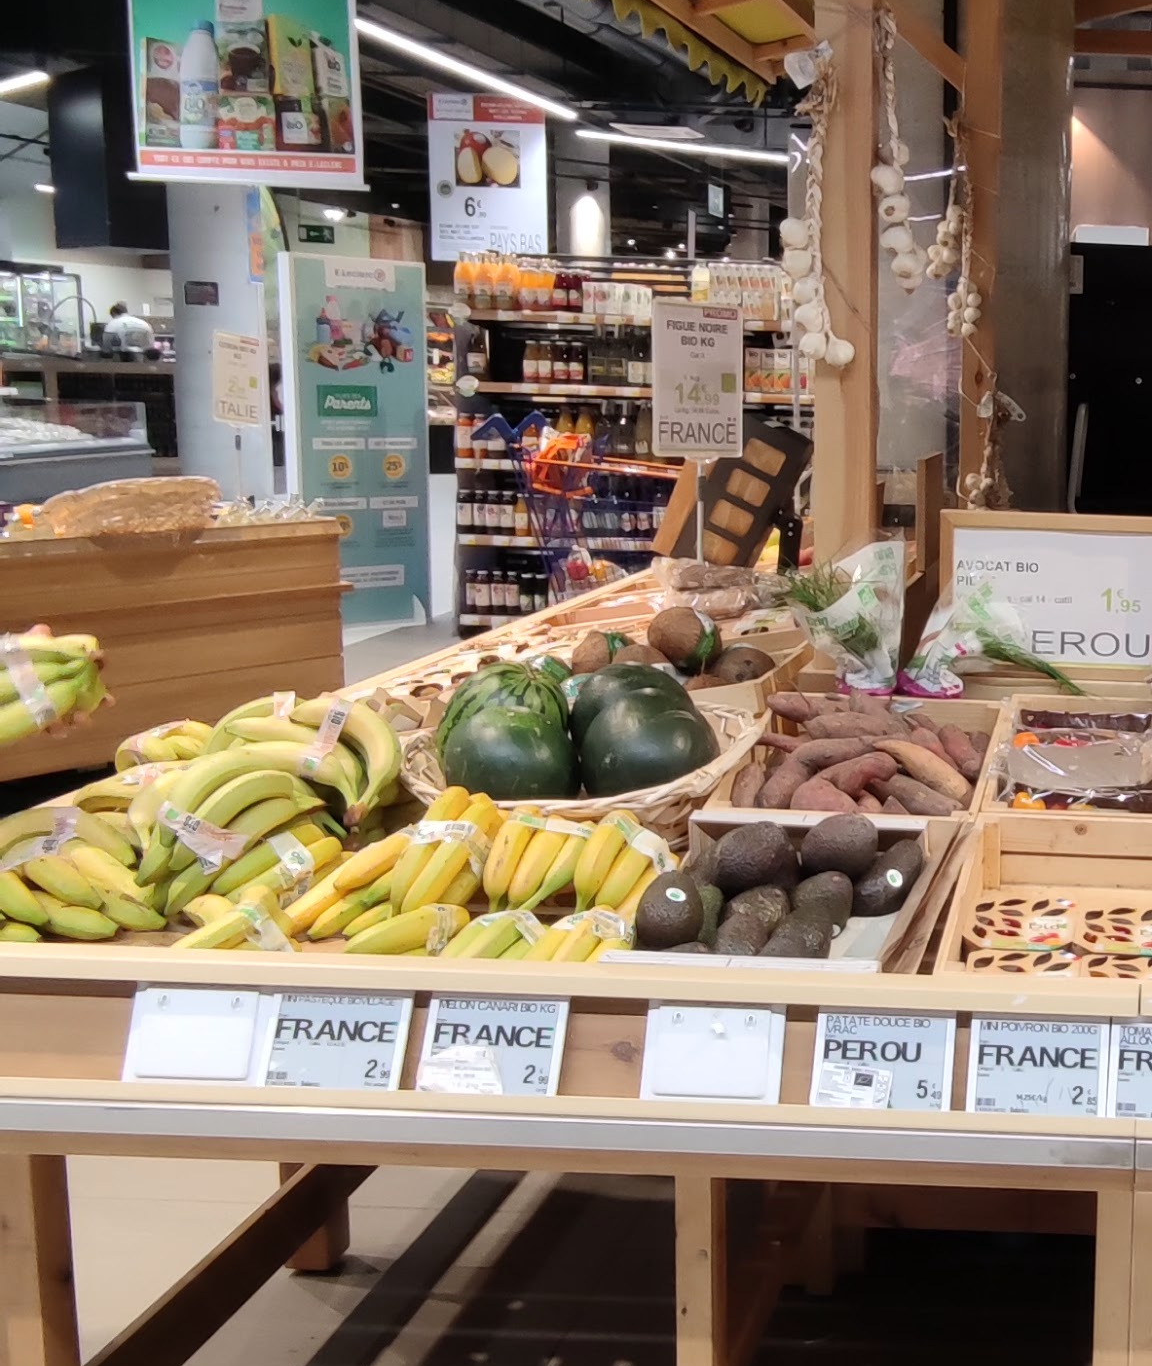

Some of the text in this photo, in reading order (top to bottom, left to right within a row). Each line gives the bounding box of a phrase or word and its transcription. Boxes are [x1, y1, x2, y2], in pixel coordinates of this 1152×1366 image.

[464, 196, 476, 217] 6
[489, 231, 516, 252] PAYS
[519, 233, 542, 254] BAS
[666, 319, 728, 335] FIGUE NOIRE
[680, 335, 715, 347] BIO KG
[658, 421, 737, 444] FRANCE
[956, 560, 1040, 574] AVOCAT BIO
[1031, 629, 1150, 659] EROU
[439, 999, 556, 1014] MELON CANARI BIO KG
[275, 1017, 399, 1044] FRANCE
[826, 1015, 931, 1029] PATATE DOUCE BIO
[826, 1024, 858, 1035] VRAC
[1000, 1022, 1050, 1033] POIVRON
[1051, 1023, 1069, 1034] BIO
[1071, 1024, 1098, 1035] 200G
[433, 1022, 554, 1049] FRANCE
[823, 1038, 923, 1063] PEROU
[978, 1043, 1098, 1070] FRANCE
[364, 1058, 378, 1079] 2
[522, 1064, 536, 1085] 2
[916, 1079, 929, 1100] 5
[1071, 1085, 1098, 1106] 2 85
